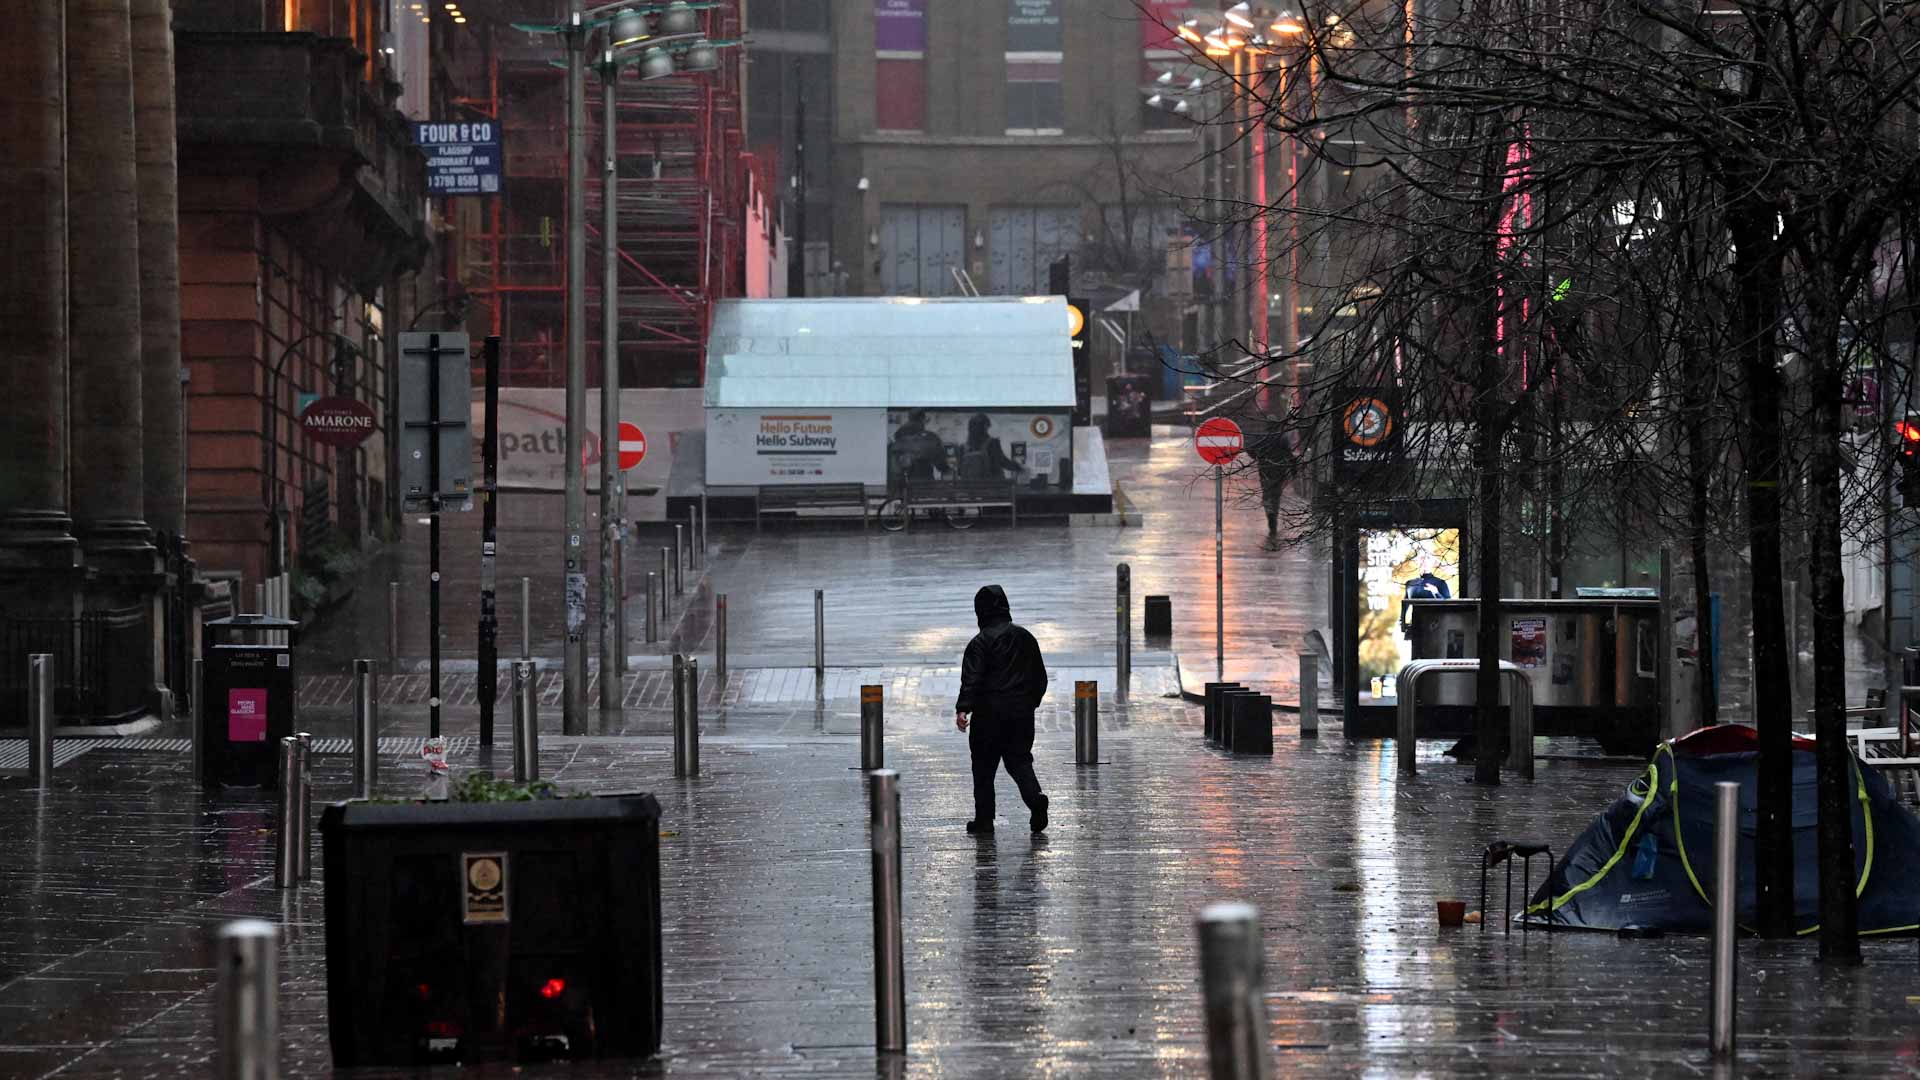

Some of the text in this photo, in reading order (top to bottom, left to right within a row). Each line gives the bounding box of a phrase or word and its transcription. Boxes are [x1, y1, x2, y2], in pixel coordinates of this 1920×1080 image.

[420, 123, 491, 142] FOUR & CO
[474, 156, 490, 166] BAR
[305, 415, 372, 428] AMARONE
[760, 422, 832, 434] Hello Future
[756, 434, 837, 449] Hello Subway
